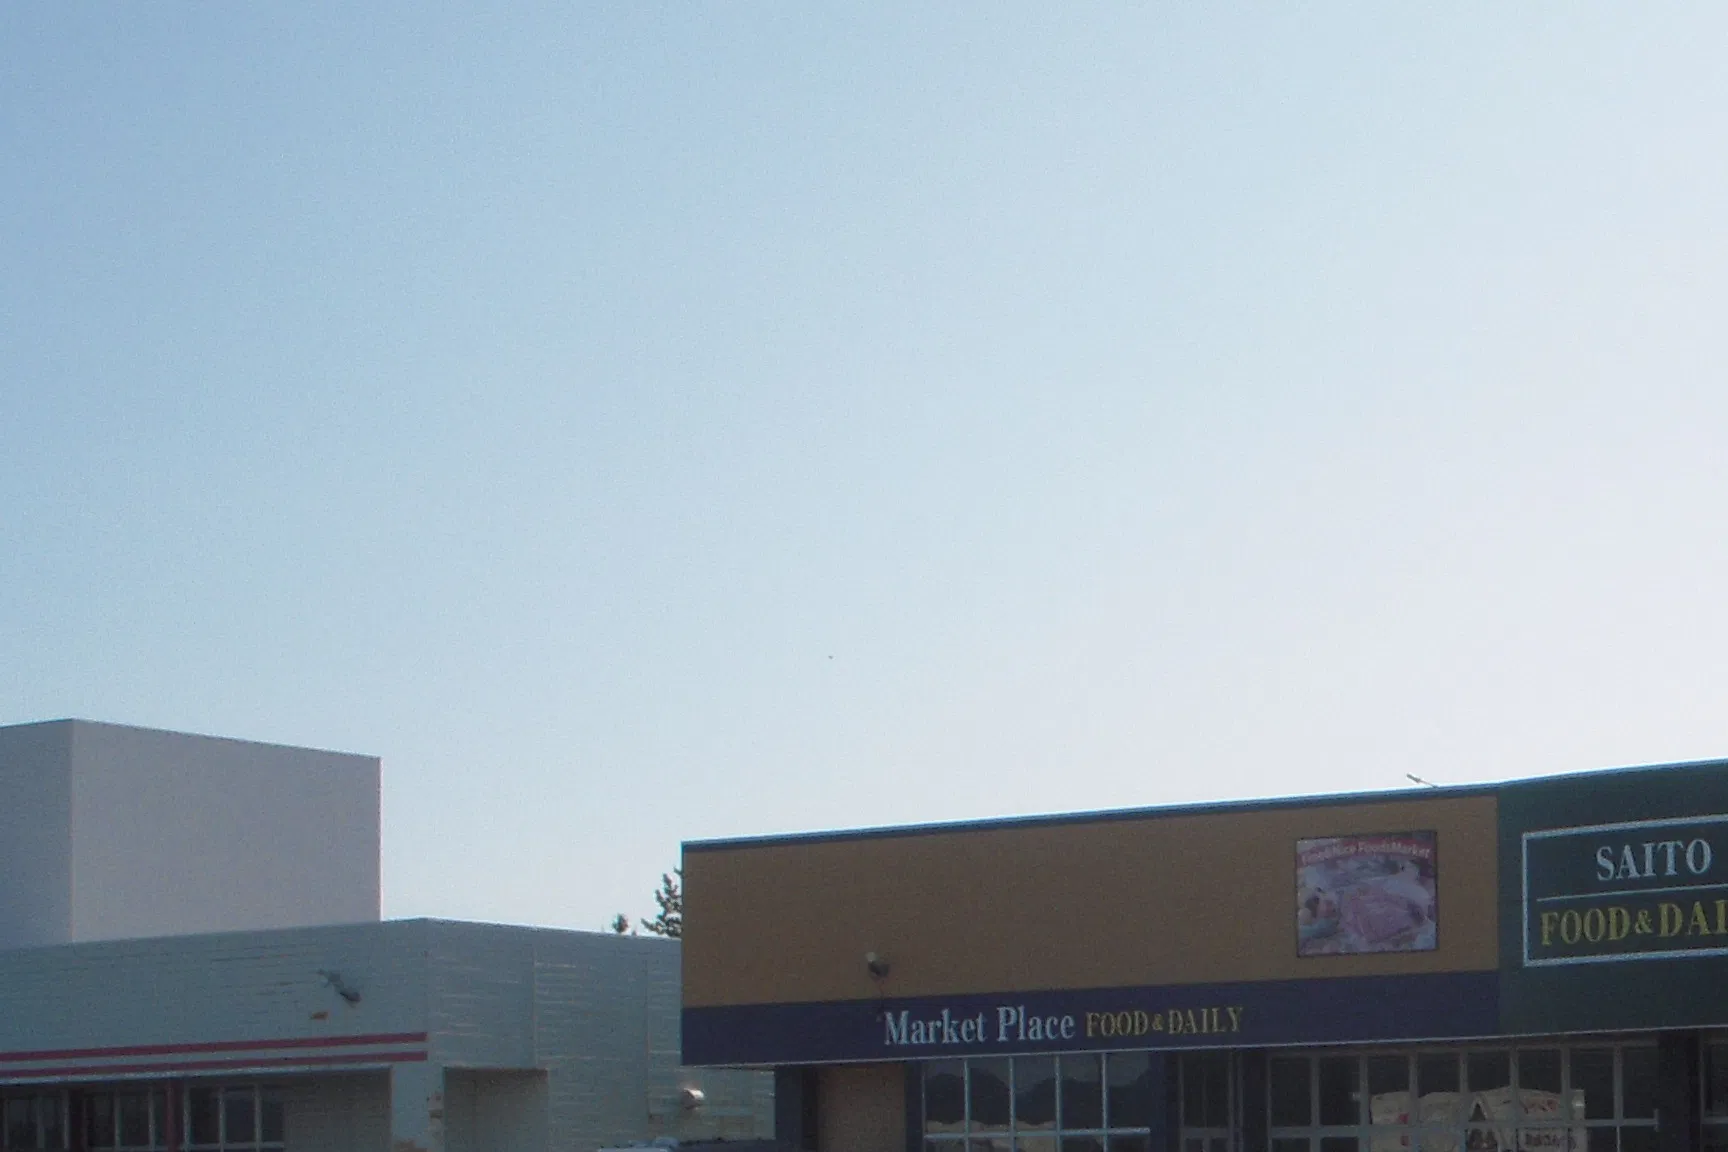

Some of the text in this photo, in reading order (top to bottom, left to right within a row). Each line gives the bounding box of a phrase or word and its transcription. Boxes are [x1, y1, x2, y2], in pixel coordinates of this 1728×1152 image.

[1596, 838, 1712, 881] SAITO
[884, 1006, 988, 1046] Market
[997, 1005, 1075, 1042] Place
